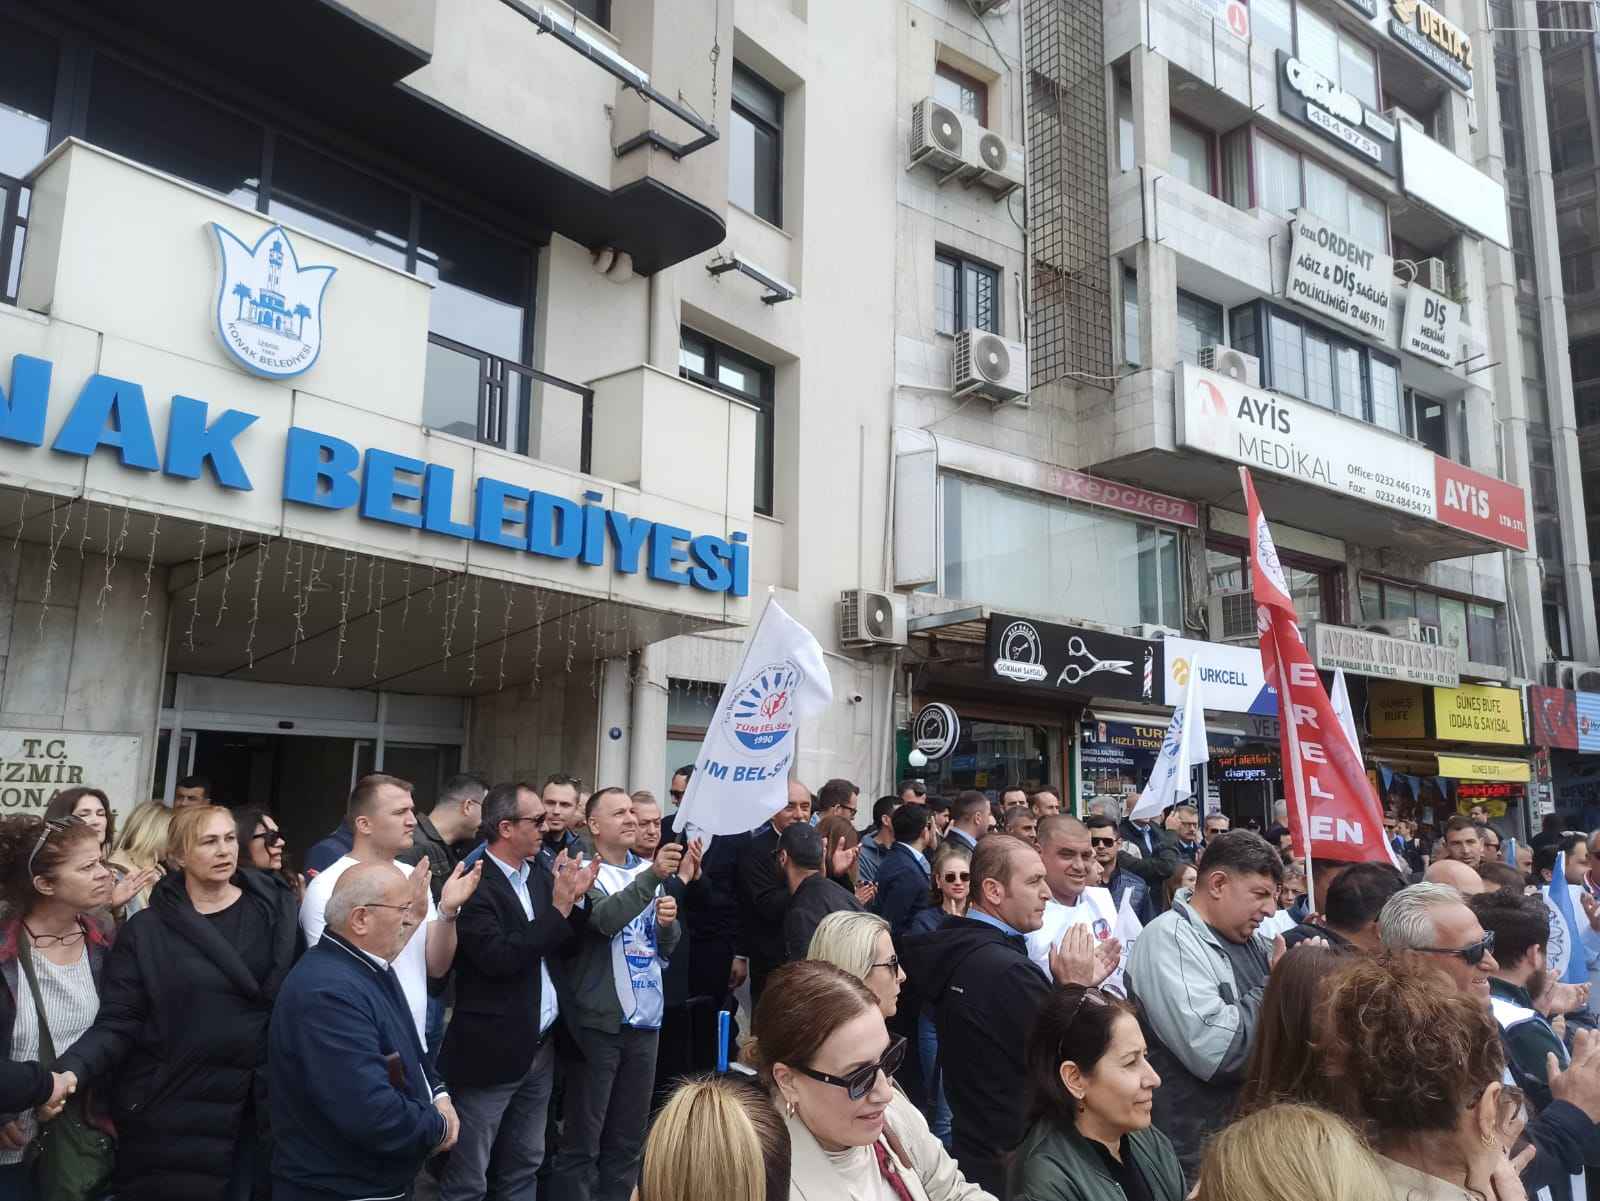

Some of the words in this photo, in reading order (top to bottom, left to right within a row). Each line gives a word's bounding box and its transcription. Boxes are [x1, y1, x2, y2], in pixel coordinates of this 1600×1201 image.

[1317, 227, 1374, 272] ORDENT
[1297, 252, 1321, 275] AĞIZ
[1323, 266, 1330, 280] &
[1333, 264, 1356, 297] DİŞ
[1424, 297, 1446, 330] DİŞ
[227, 321, 257, 359] KONAK
[259, 343, 312, 368] BELEDİYESİ
[1237, 395, 1291, 434] AYİS
[1443, 478, 1490, 519] AYİS
[1239, 431, 1338, 486] MEDİKAL
[1347, 464, 1374, 481] Office:
[1374, 472, 1394, 488] 0232
[1348, 481, 1366, 496] Fax:
[1375, 489, 1395, 504] 0232
[284, 426, 749, 597] BELEDİYESİ
[1474, 717, 1480, 730] &
[23, 739, 68, 760] T.C.
[1111, 736, 1135, 746] HIZLI
[1225, 768, 1266, 780] chargers
